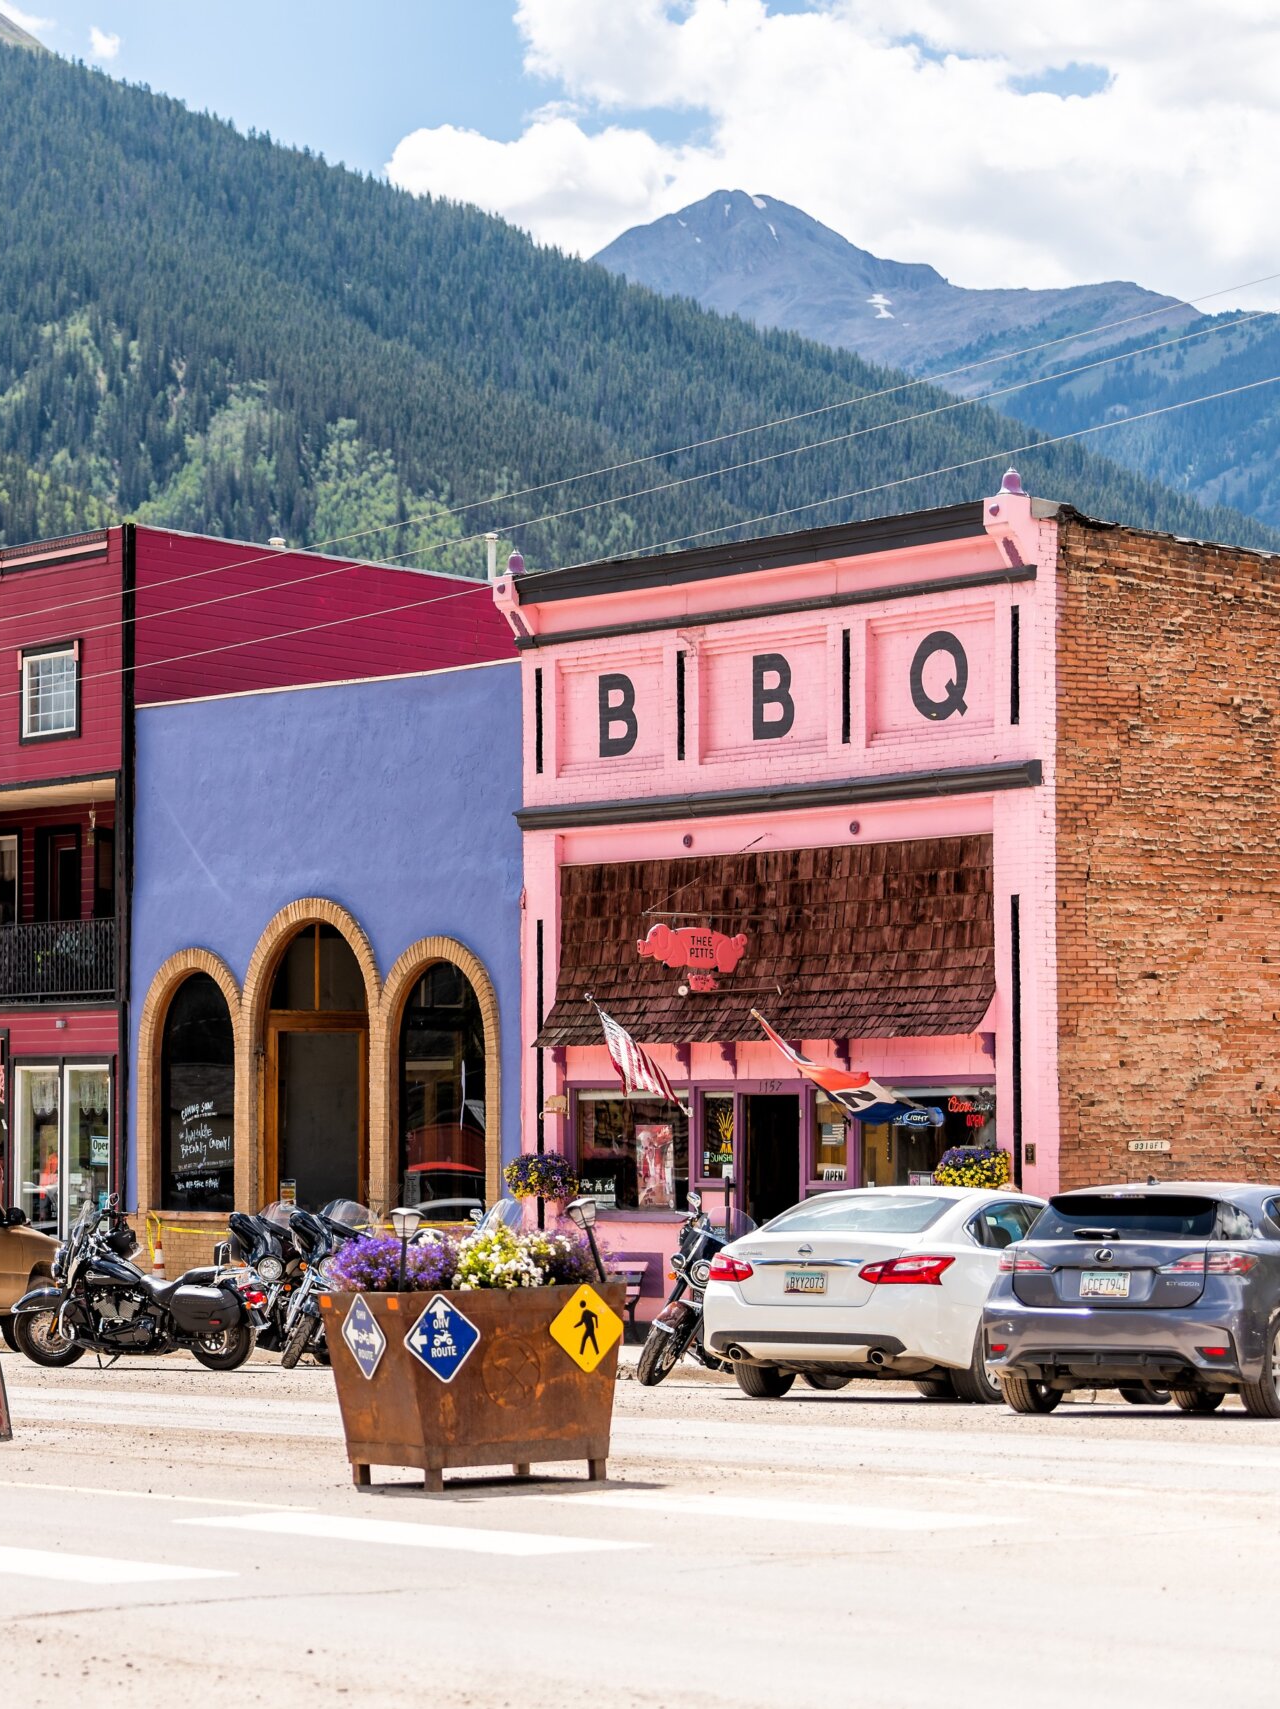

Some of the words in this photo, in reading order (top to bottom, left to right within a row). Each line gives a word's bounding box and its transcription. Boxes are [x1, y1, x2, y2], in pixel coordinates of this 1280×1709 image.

[690, 935, 712, 947] THEE
[689, 947, 714, 959] PITTS
[759, 1081, 783, 1094] 1157
[966, 1114, 985, 1128] OPEN
[710, 1152, 733, 1163] SUNSHI
[825, 1170, 844, 1181] OPEN
[790, 1277, 825, 1289] BYY2073
[1087, 1278, 1127, 1291] CCF7941
[433, 1316, 450, 1329] OHV
[357, 1348, 375, 1361] ROUTE
[431, 1346, 458, 1358] ROUTE
